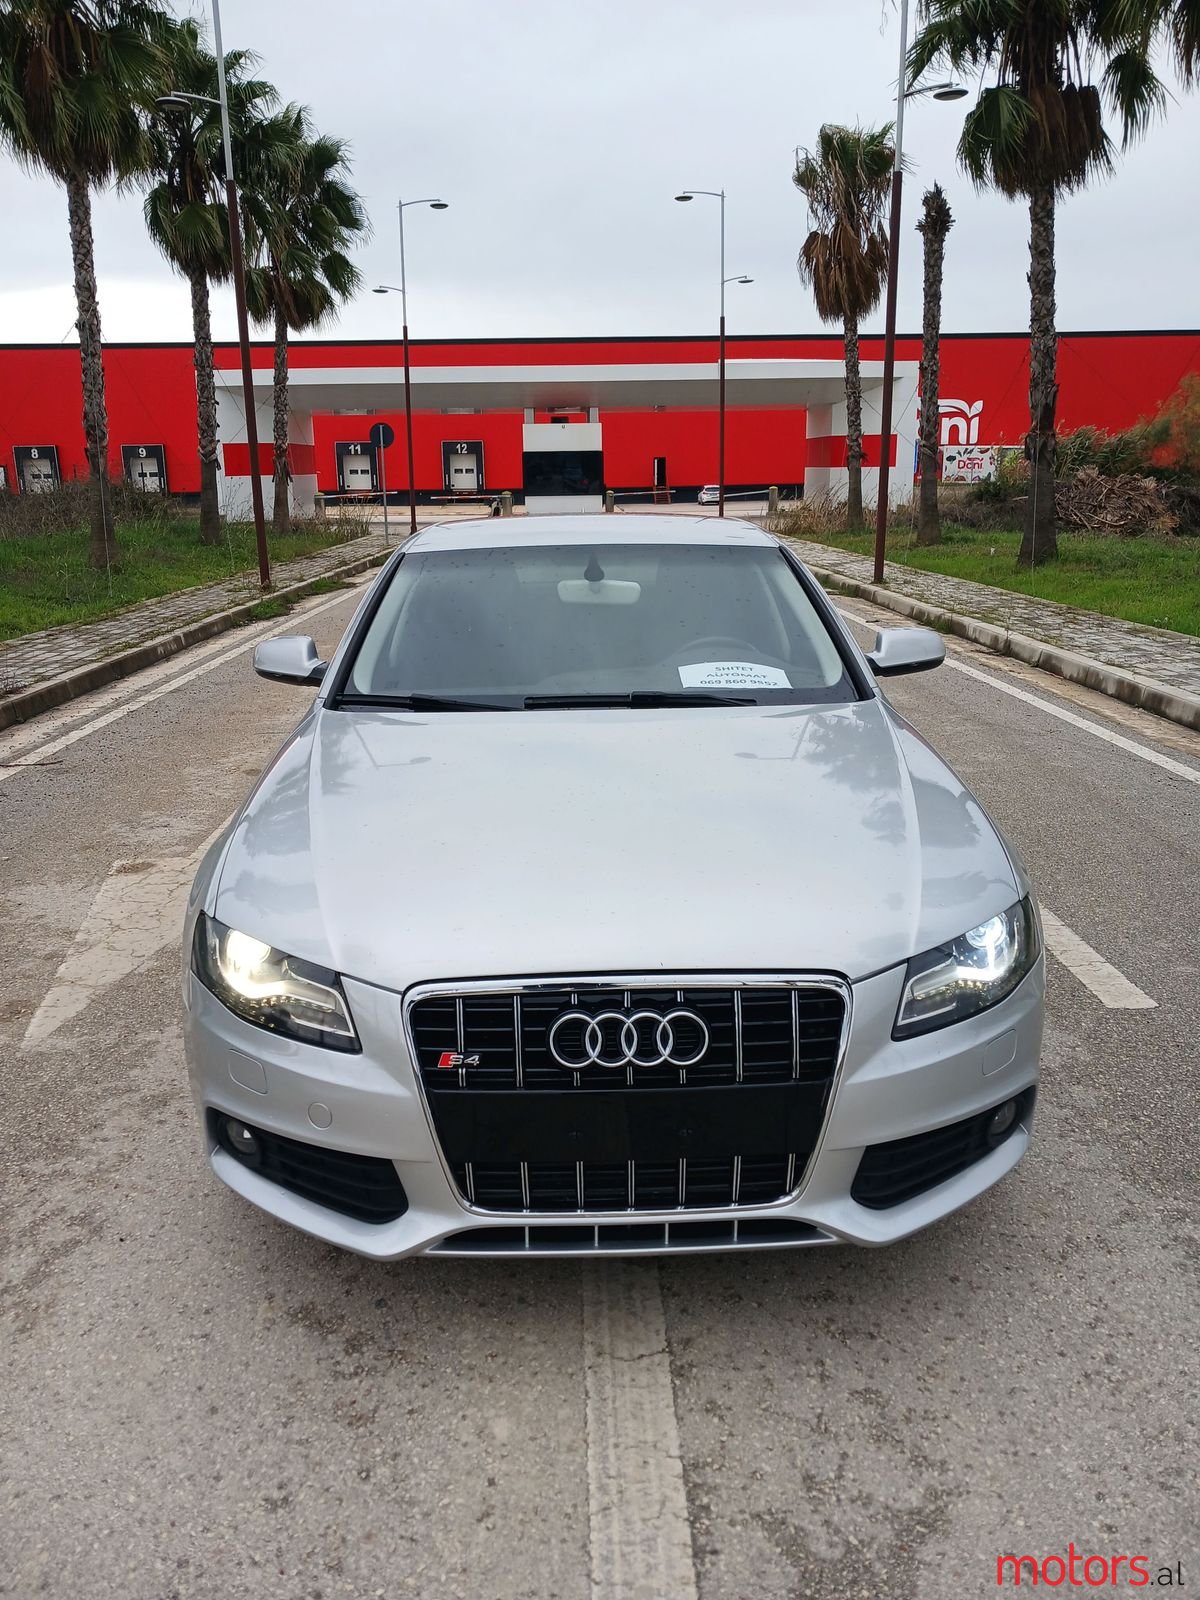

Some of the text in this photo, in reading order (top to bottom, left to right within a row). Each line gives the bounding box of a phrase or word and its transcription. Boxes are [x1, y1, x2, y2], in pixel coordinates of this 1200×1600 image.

[30, 448, 39, 459] 8
[138, 447, 147, 458] 9
[348, 444, 361, 455] 11
[455, 443, 468, 454] 12
[706, 671, 768, 679] AUTOMAT
[446, 1053, 480, 1067] S4
